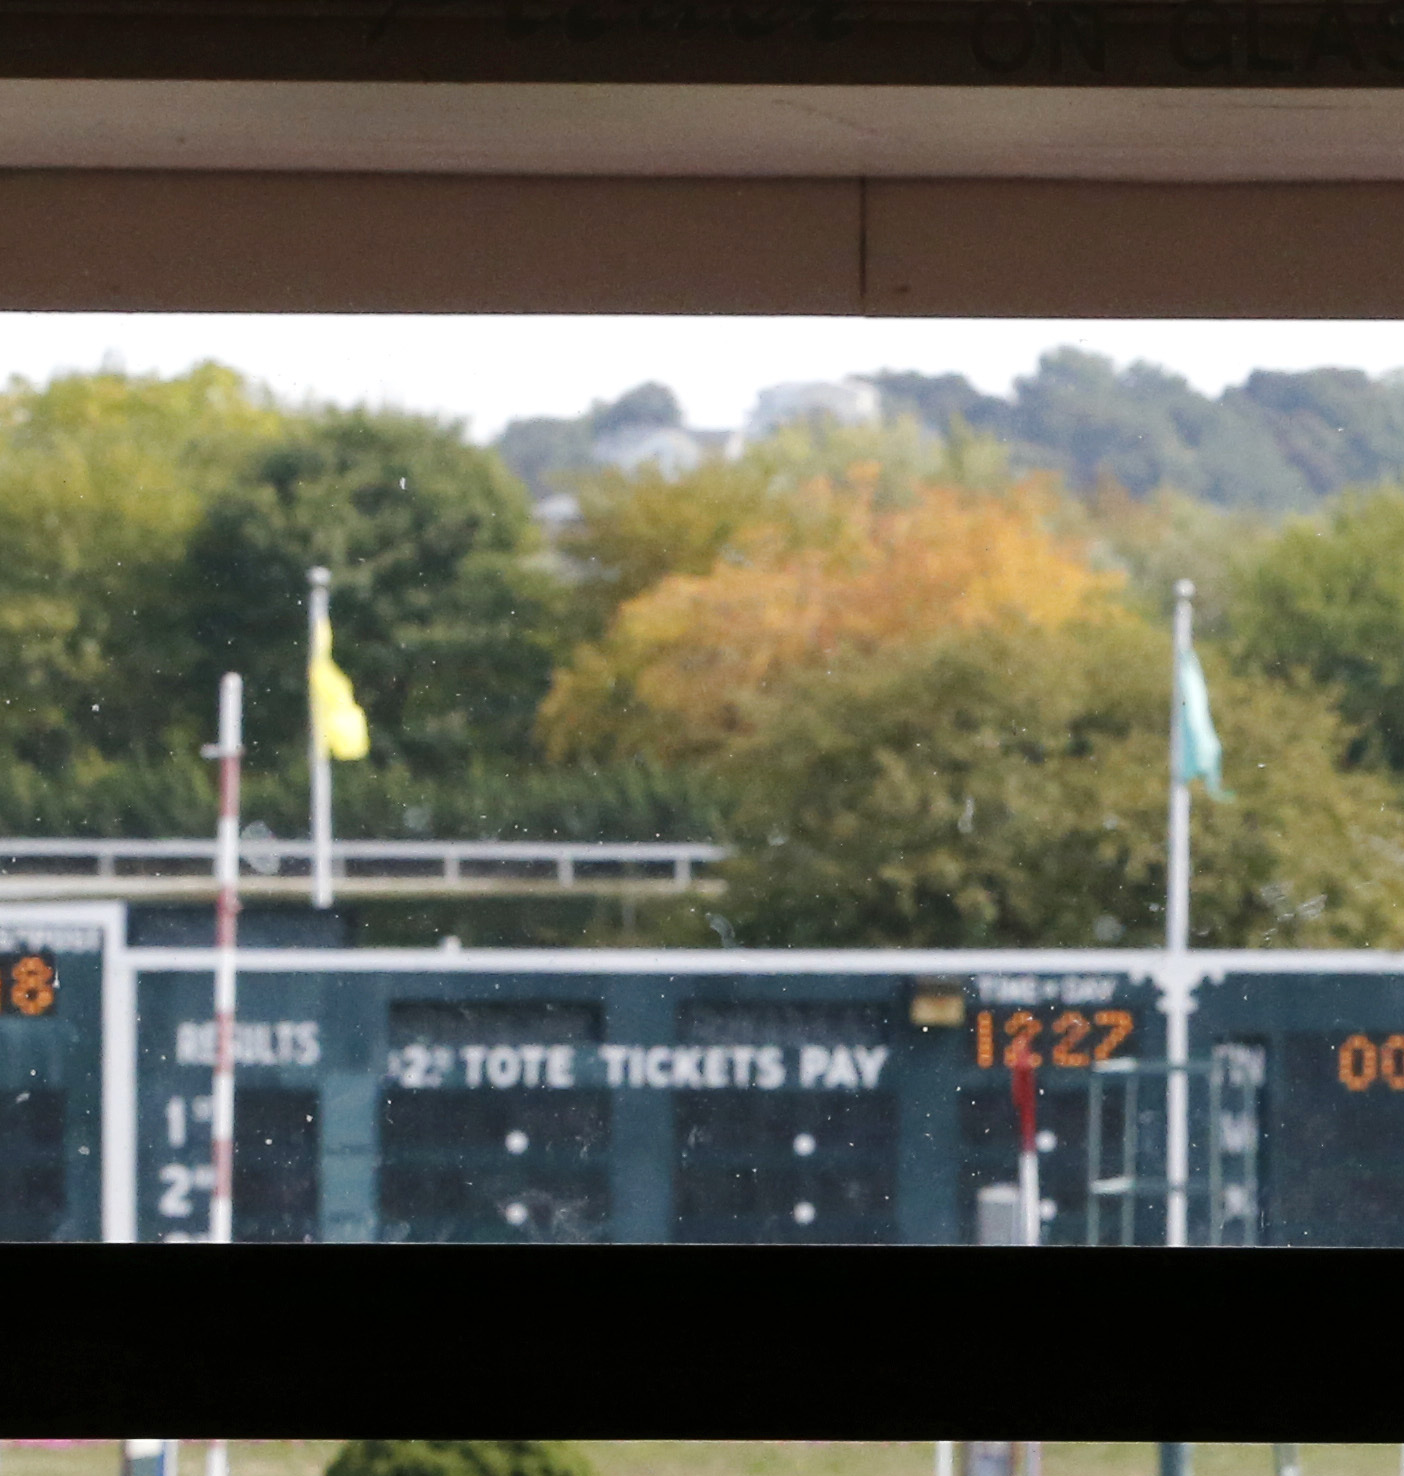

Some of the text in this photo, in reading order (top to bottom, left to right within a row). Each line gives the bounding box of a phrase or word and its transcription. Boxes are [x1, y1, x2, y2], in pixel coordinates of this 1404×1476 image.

[176, 1020, 321, 1066] REULTS
[460, 1044, 575, 1089] TOTE
[598, 1044, 785, 1090] TICKETS
[799, 1044, 889, 1089] PAY
